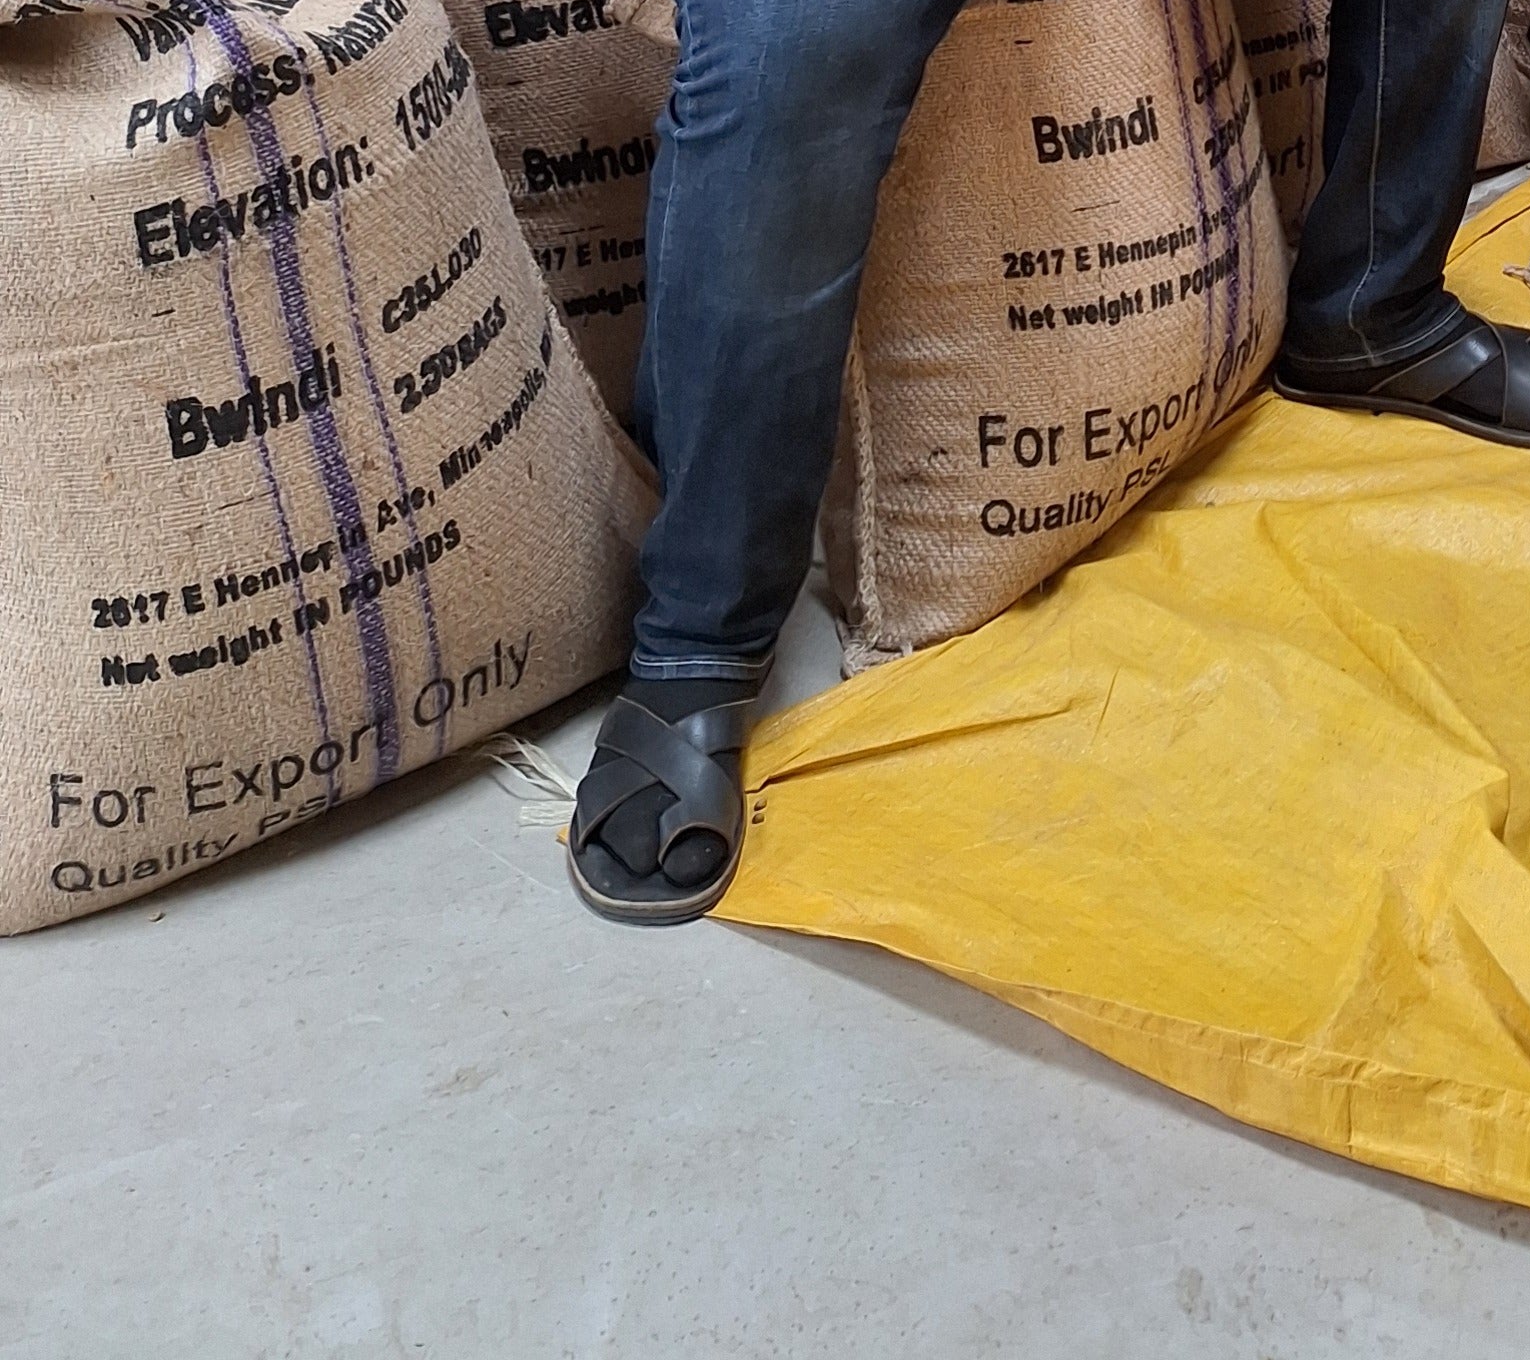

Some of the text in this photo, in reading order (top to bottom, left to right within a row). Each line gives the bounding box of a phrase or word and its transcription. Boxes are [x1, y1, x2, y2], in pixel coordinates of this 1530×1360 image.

[125, 46, 315, 149] Process:
[1031, 96, 1161, 166] Bwindi
[132, 134, 377, 268] Elevation:
[1073, 245, 1093, 273] E
[1097, 222, 1198, 270] Hennepin
[1006, 303, 1057, 333] Net
[1060, 287, 1145, 327] weight
[1150, 278, 1174, 311] IN
[165, 340, 345, 461] Bwindi
[977, 410, 1064, 470] For
[1083, 372, 1206, 465] Export
[979, 485, 1113, 540] Quality
[168, 618, 285, 677] weight
[293, 594, 331, 636] IN
[341, 519, 463, 615] POUNDS
[183, 583, 207, 618] E
[50, 629, 536, 830] For Export Only
[51, 829, 239, 894] Quality
